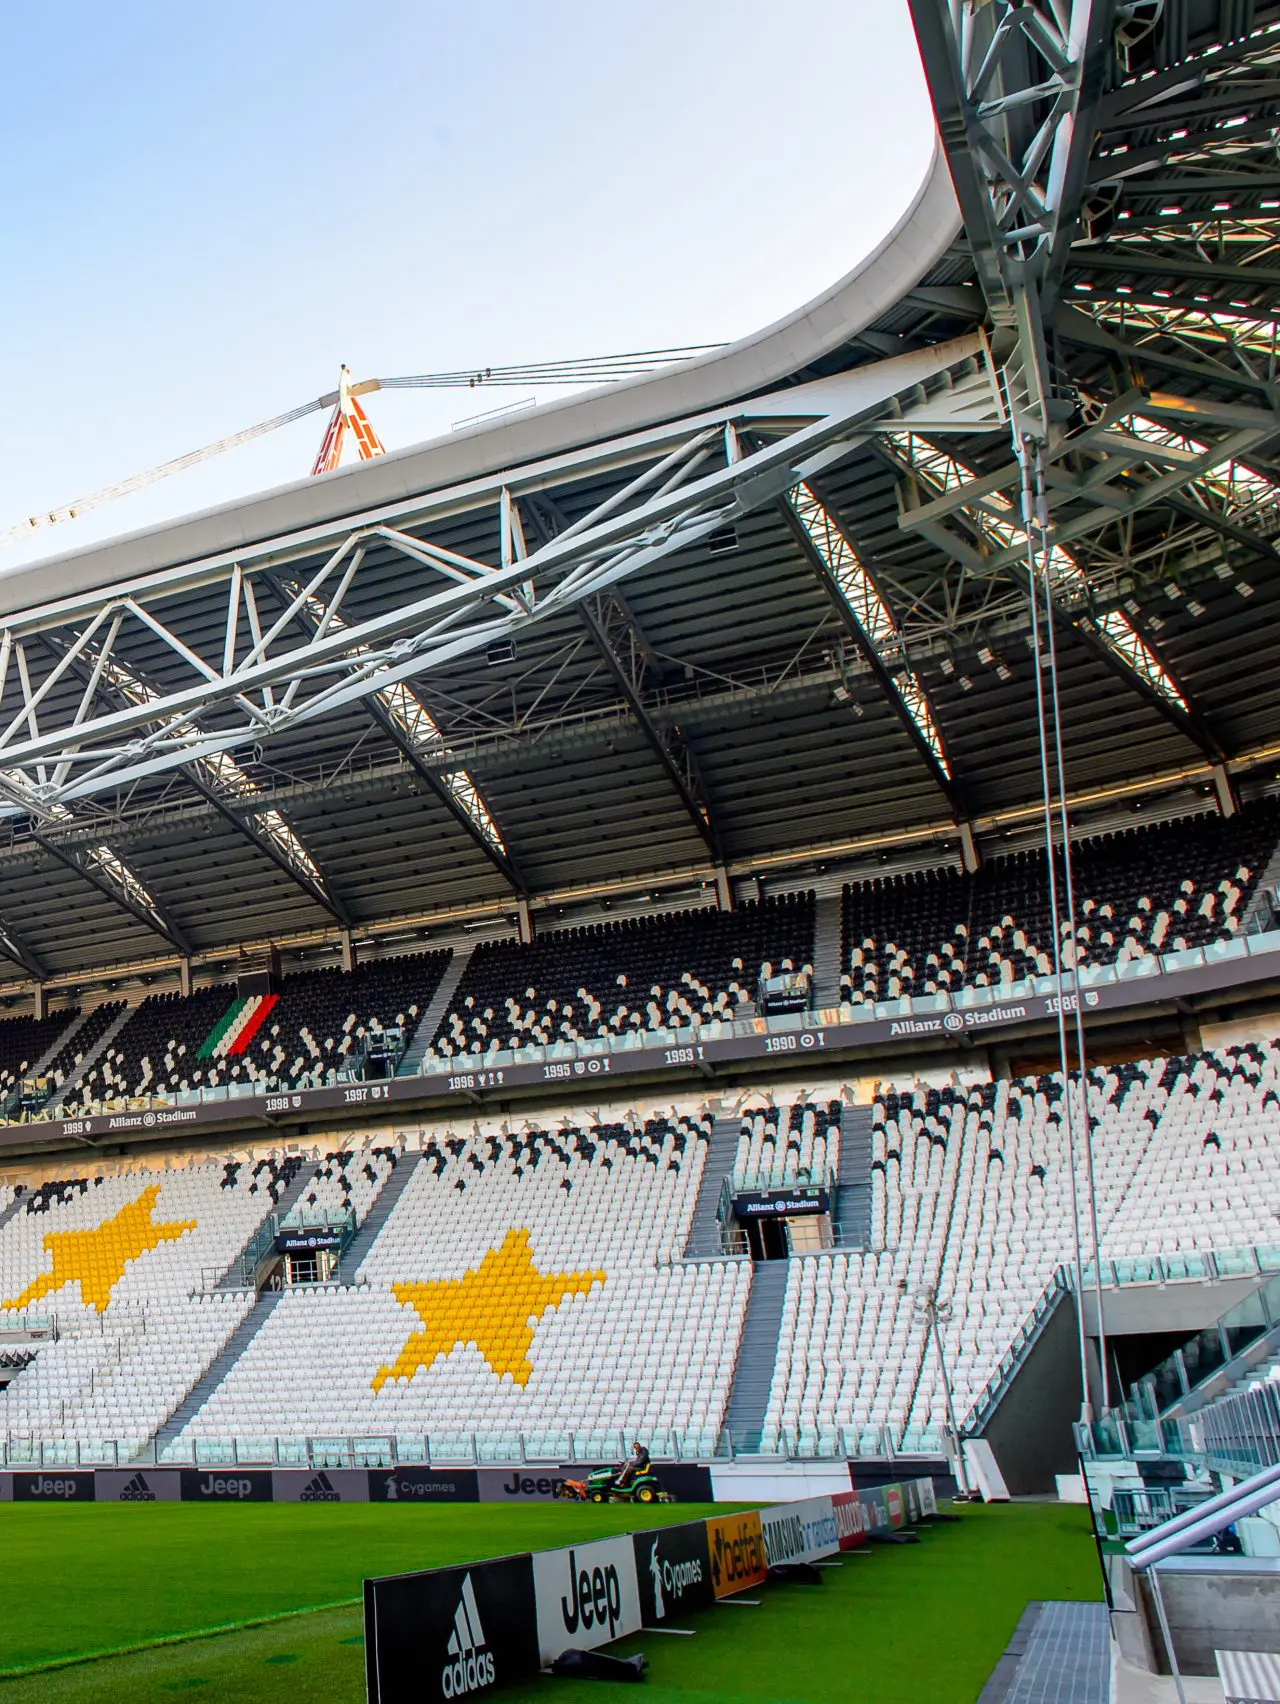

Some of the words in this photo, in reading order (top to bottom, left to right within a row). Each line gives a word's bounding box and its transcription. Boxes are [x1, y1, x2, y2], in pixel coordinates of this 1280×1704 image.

[891, 1019, 942, 1035] Allianz
[965, 1006, 1026, 1025] Stadium
[765, 1036, 796, 1052] 1990
[665, 1048, 694, 1064] 1993
[544, 1065, 570, 1079] 1995
[448, 1075, 475, 1089] 1996
[344, 1088, 368, 1102] 1997
[266, 1098, 289, 1111] 1998
[109, 1117, 142, 1129] Allianz
[157, 1110, 197, 1123] Stadium
[63, 1123, 83, 1135] 1999
[747, 1203, 775, 1212] Allianz
[786, 1200, 819, 1209] Stadium
[286, 1238, 307, 1247] Allianz
[31, 1476, 77, 1498] Jeep
[201, 1475, 252, 1498] Jeep
[400, 1482, 456, 1494] Cygames
[120, 1492, 156, 1502] adidas
[300, 1491, 341, 1502] adidas
[762, 1515, 805, 1565] SAMSUNG
[722, 1522, 762, 1582] betfair
[664, 1558, 702, 1596] Cygames
[562, 1550, 620, 1639] Jeep
[442, 1648, 496, 1699] adidas
